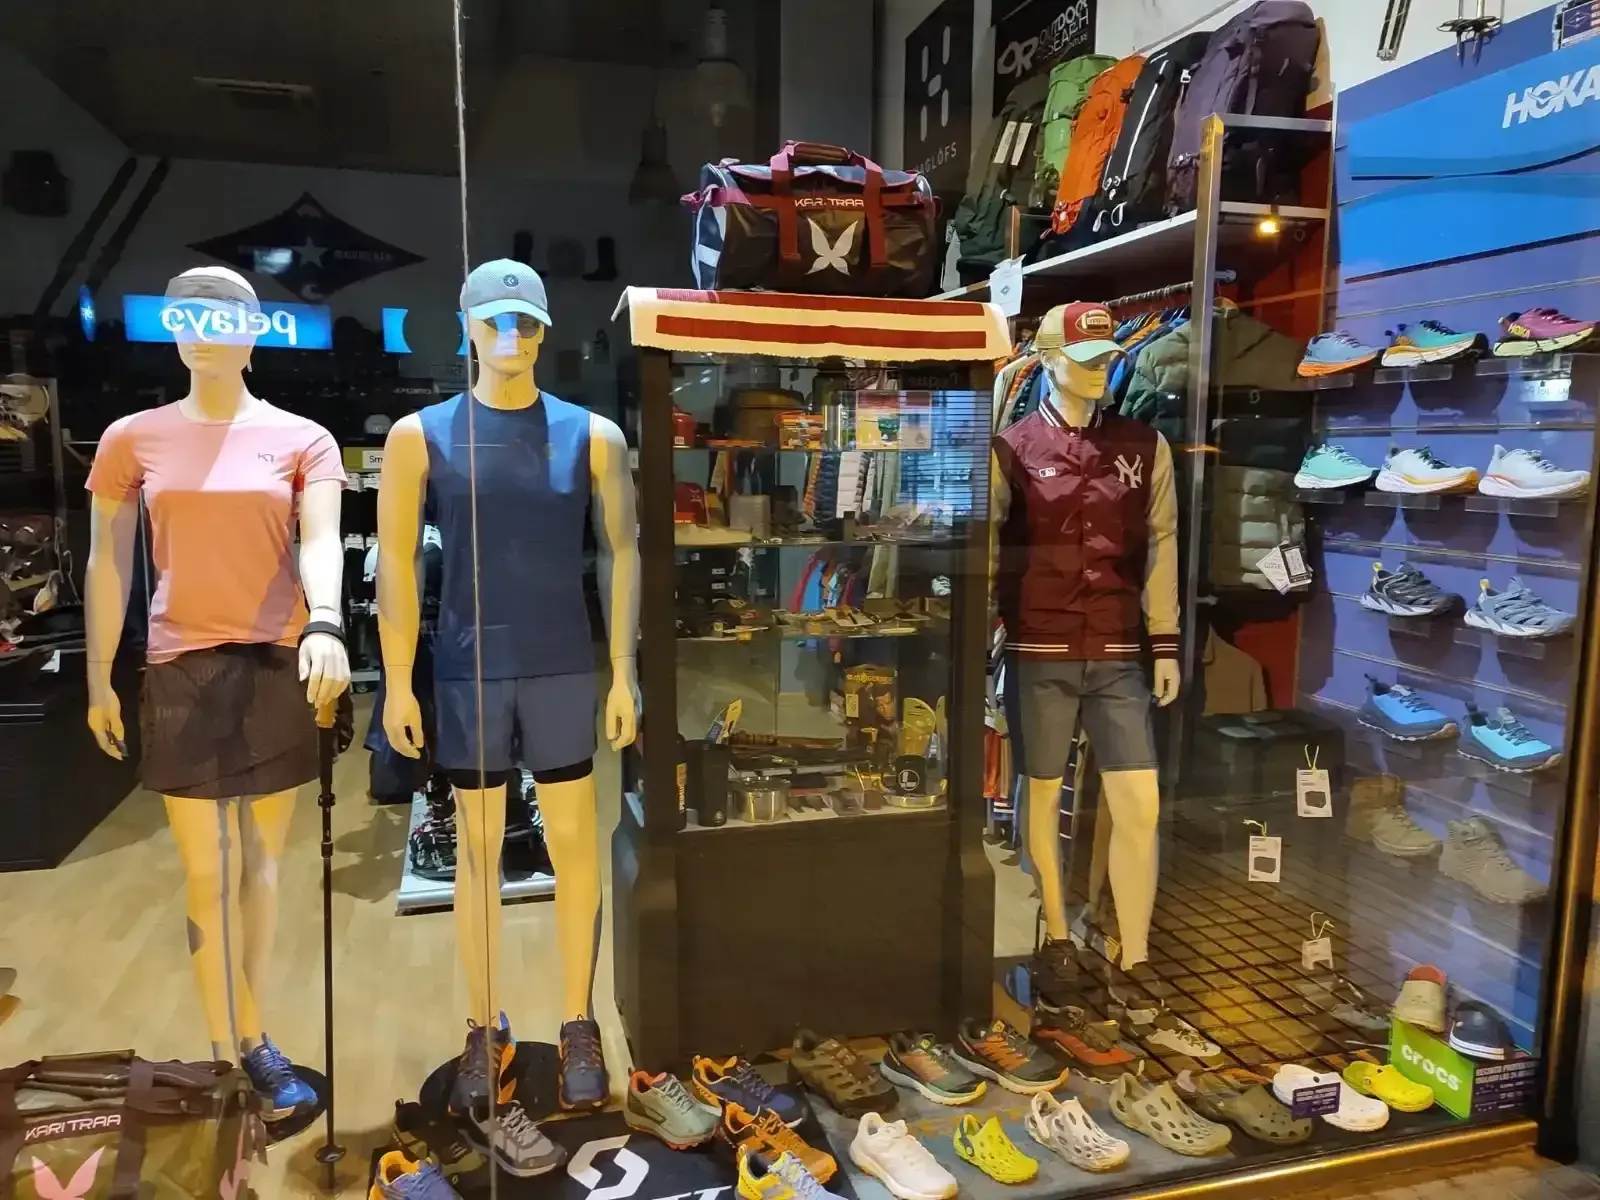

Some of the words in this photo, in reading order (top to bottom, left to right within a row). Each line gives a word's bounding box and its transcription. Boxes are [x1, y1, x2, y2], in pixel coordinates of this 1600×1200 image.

[1502, 64, 1600, 128] HOKA
[828, 198, 865, 207] TRAA
[1401, 1044, 1460, 1091] crocs
[25, 1121, 65, 1141] KARI
[67, 1114, 121, 1132] TRAA
